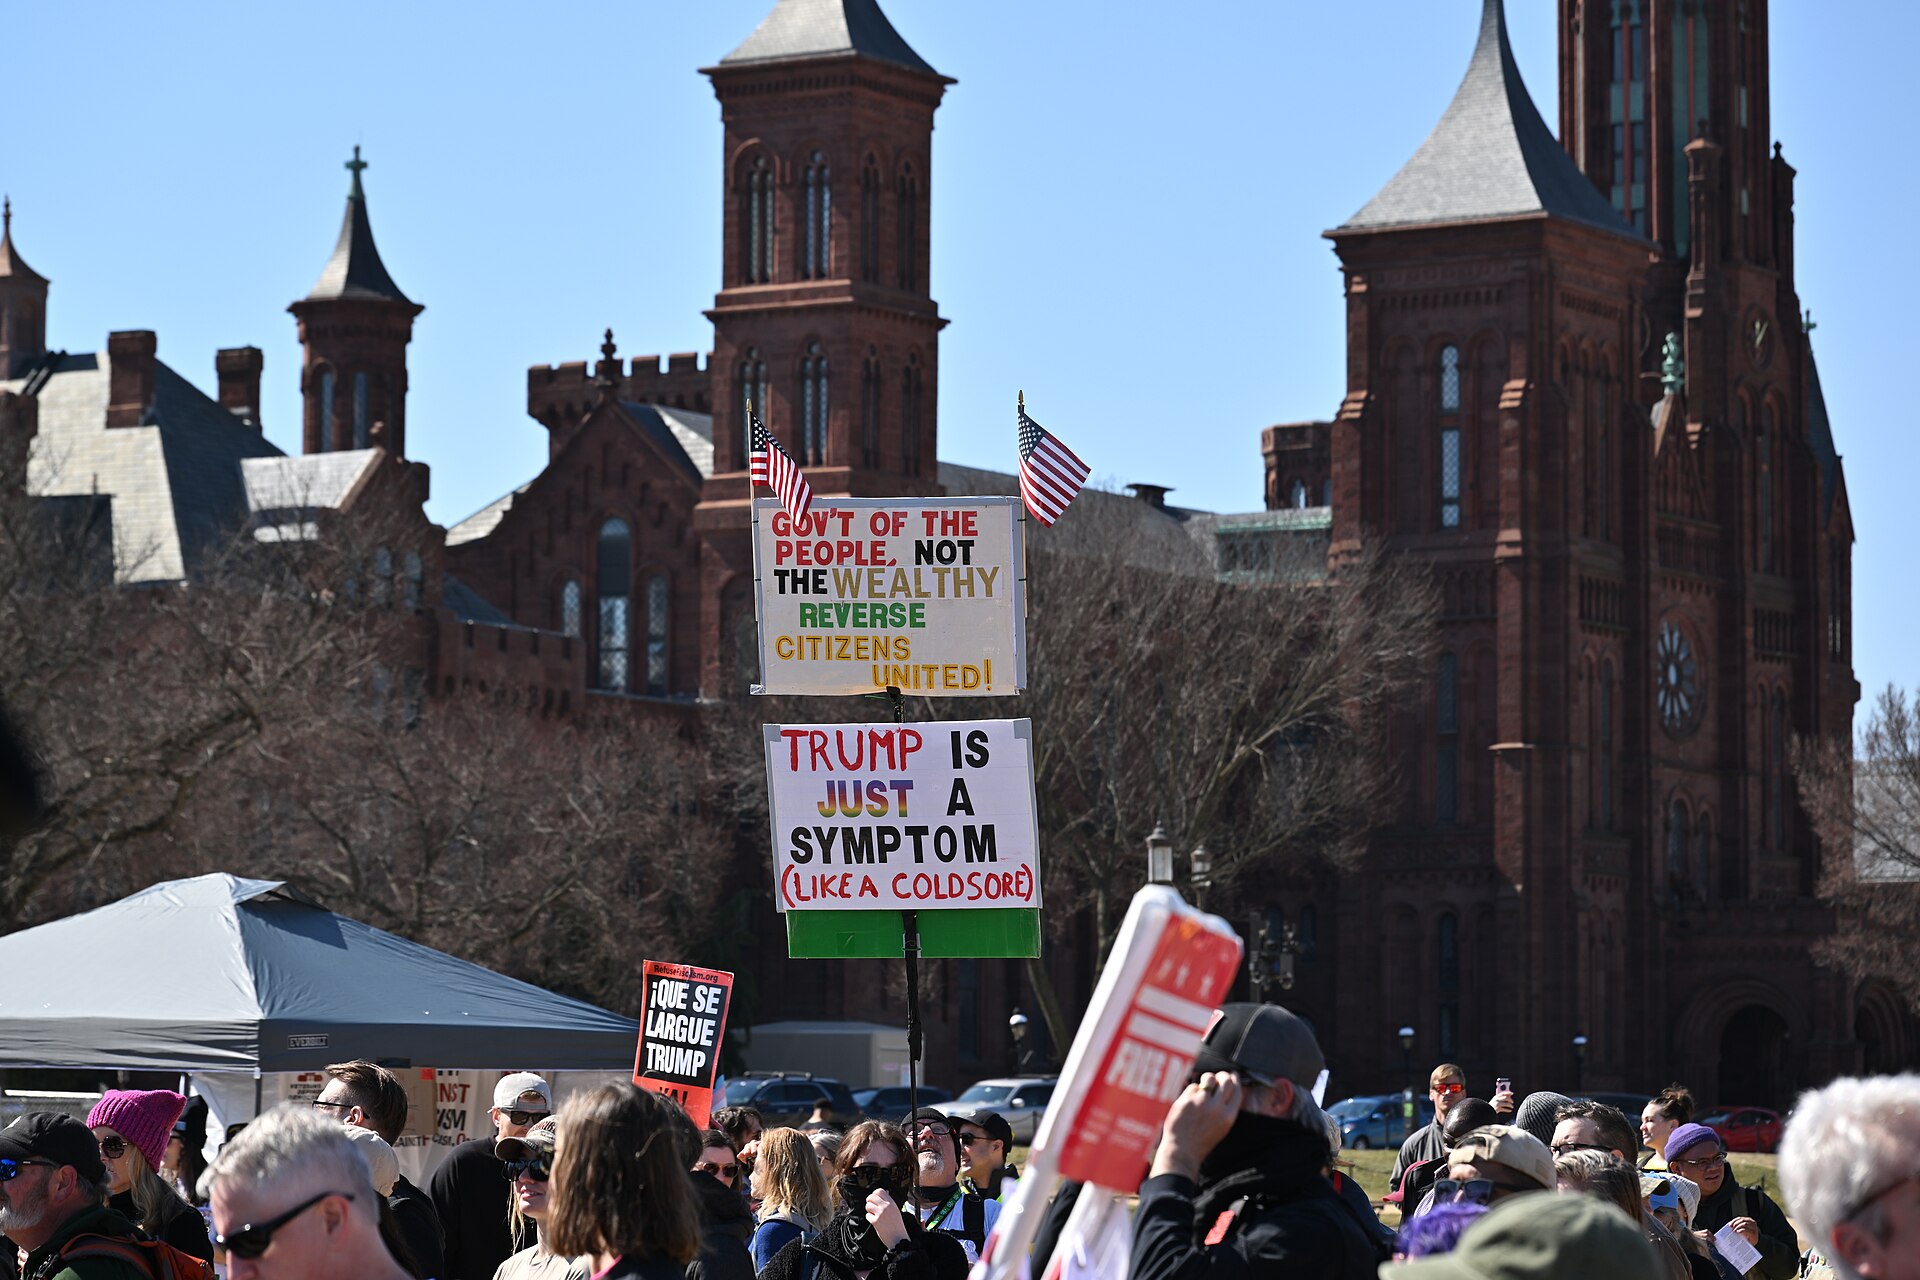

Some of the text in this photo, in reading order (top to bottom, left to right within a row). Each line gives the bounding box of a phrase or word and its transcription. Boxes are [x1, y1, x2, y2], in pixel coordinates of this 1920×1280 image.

[771, 508, 979, 537] GOV'T OF THE
[775, 539, 975, 567] PEOPLE, NOT
[773, 566, 1000, 599] THE WEALTHY
[799, 602, 927, 629] REVERSE
[775, 635, 911, 662] CITIZENS
[871, 659, 993, 692] UNITED!
[780, 728, 990, 772] TRUMP IS
[816, 777, 976, 818] JUST A
[789, 824, 998, 865] SYMPTOM
[781, 863, 854, 908] (LIKE
[858, 874, 879, 898] A
[650, 978, 722, 1015] ¡QUE SE
[645, 1010, 716, 1047] LARGUE
[645, 1042, 707, 1078] TRUMP
